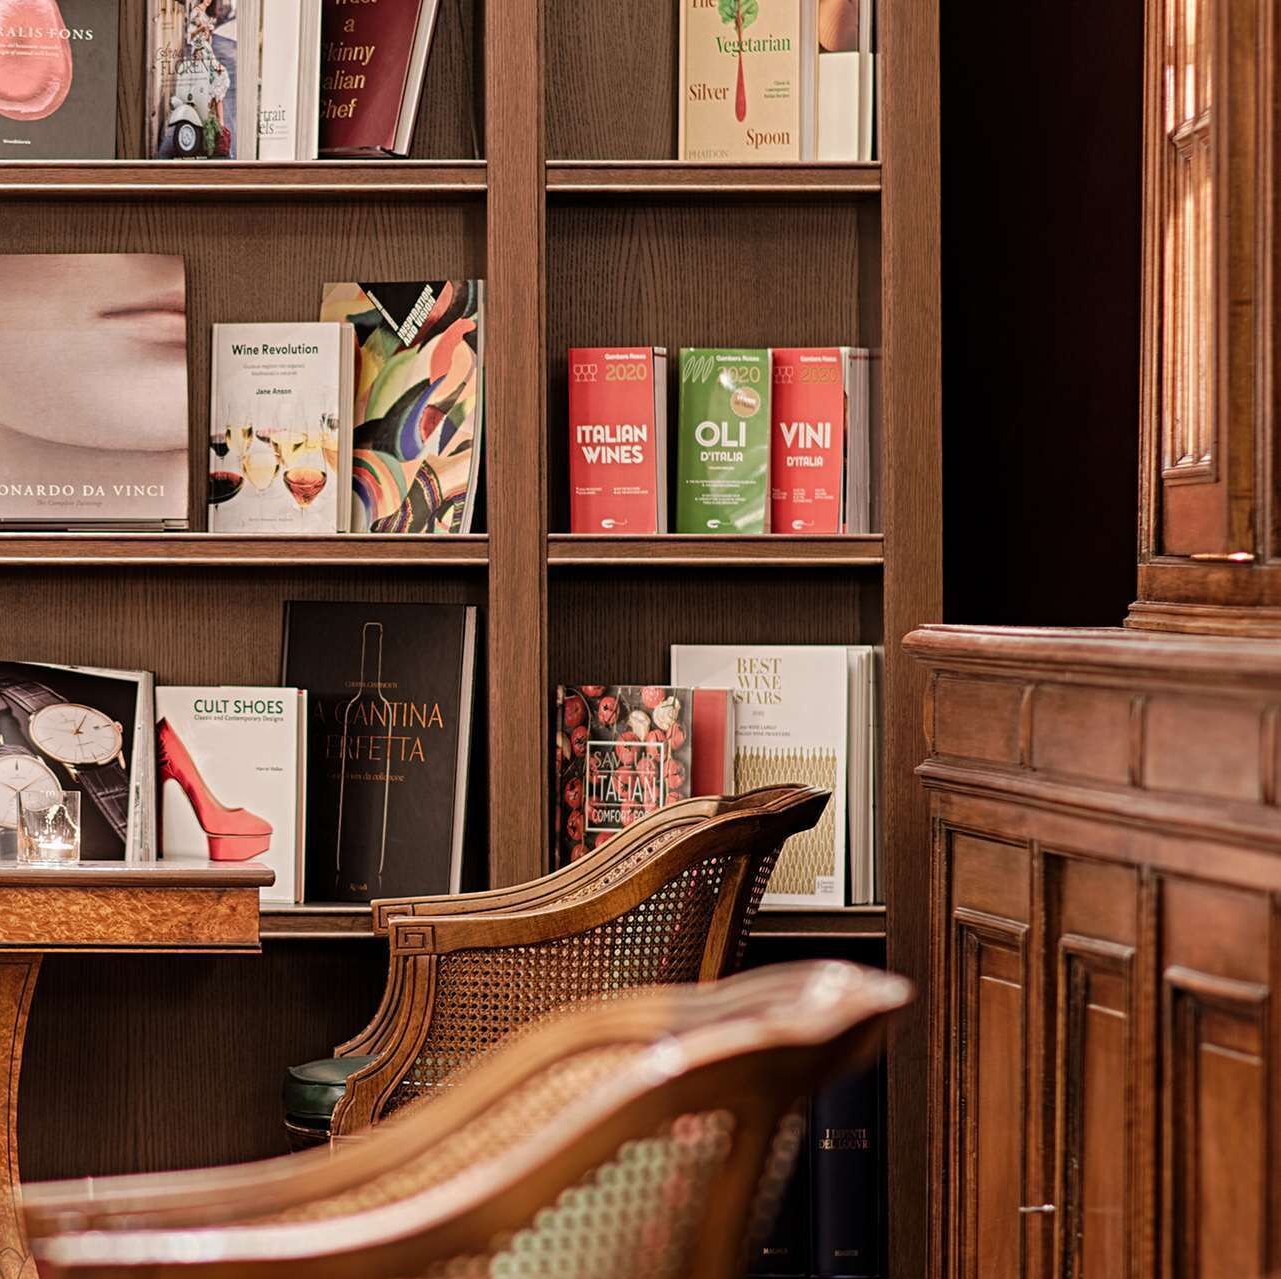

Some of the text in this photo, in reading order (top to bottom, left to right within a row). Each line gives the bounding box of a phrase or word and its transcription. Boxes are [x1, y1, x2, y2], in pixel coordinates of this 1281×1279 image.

[48, 26, 94, 40] FONS
[343, 18, 355, 32] a
[323, 42, 375, 66] kinny
[716, 33, 791, 58] Vegetarian
[322, 70, 366, 90] alian
[689, 83, 729, 102] Silver
[259, 104, 287, 122] rtrait
[746, 127, 791, 150] Spoon
[397, 284, 434, 340] INSPIRATION
[403, 295, 436, 347] AND VISION
[232, 343, 319, 355] Wine Revolution
[605, 363, 648, 382] 2020
[799, 367, 839, 385] 2020
[576, 424, 648, 444] ITALIAN
[695, 420, 747, 448] OLI
[779, 421, 831, 449] VINI
[581, 445, 645, 465] WINES
[700, 451, 745, 463] D'ITALIA
[786, 455, 824, 468] D'ITALIA
[83, 484, 105, 497] DA
[113, 485, 165, 497] VINCI
[736, 657, 782, 675] BEST
[736, 674, 782, 690] WINE
[194, 699, 284, 714] CULT SHOES
[735, 690, 783, 705] STARS
[225, 714, 262, 723] Contemporary
[263, 715, 284, 723] Designs
[334, 701, 444, 728] CANTINA
[326, 735, 426, 763] ERFETTA
[592, 774, 657, 803] ITALIAN
